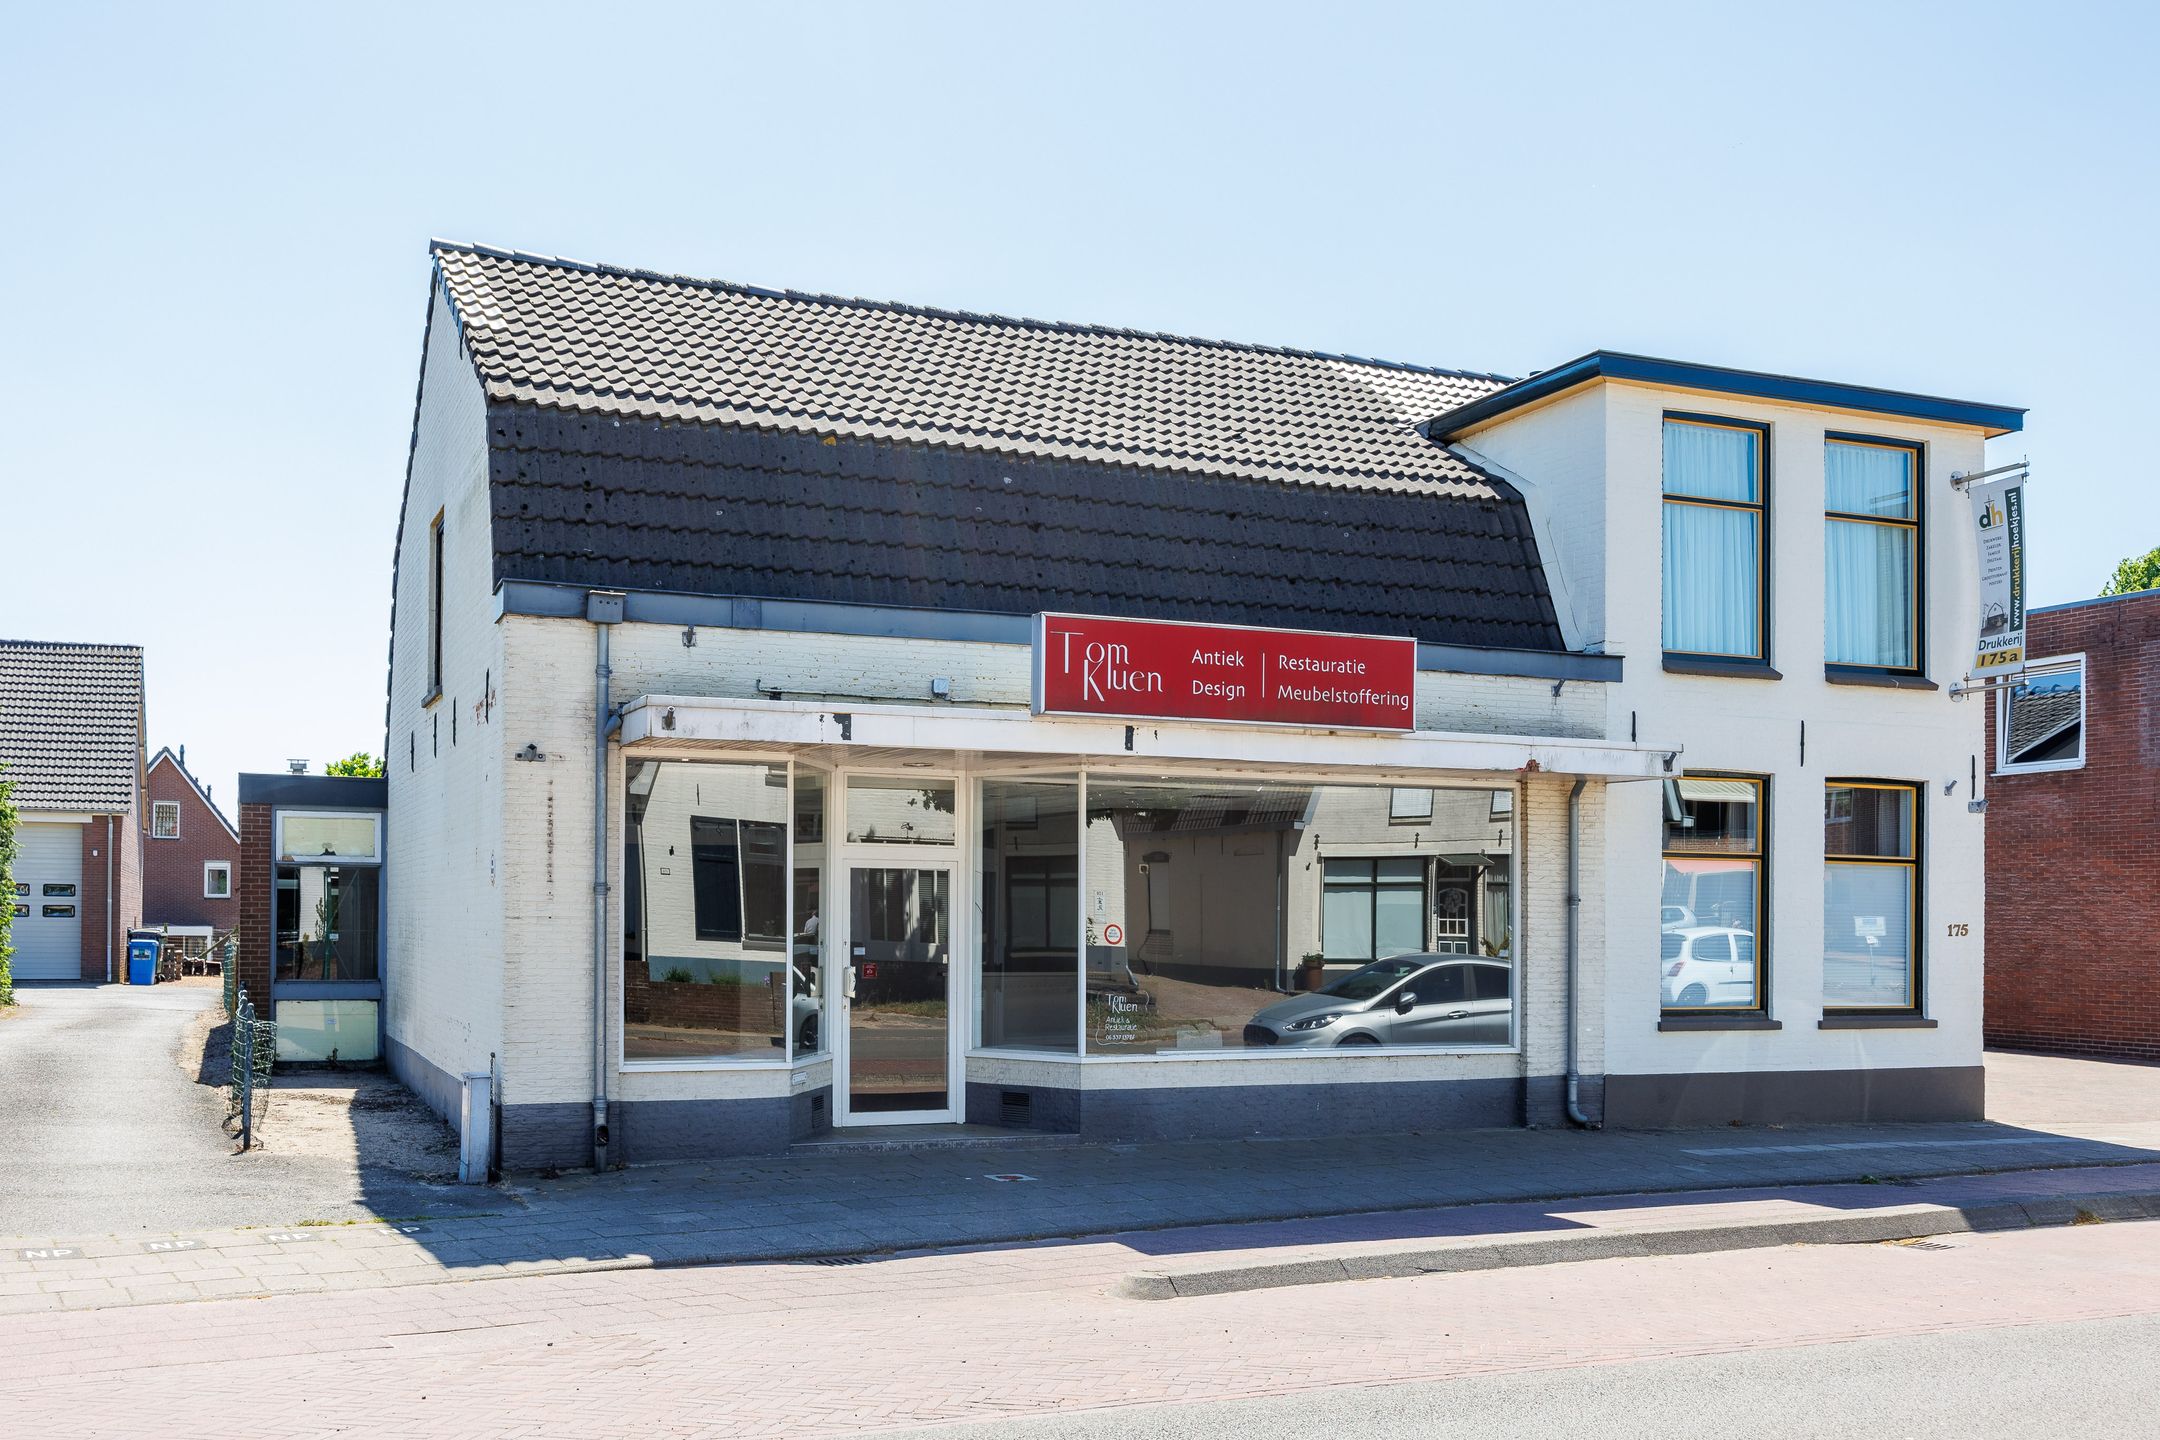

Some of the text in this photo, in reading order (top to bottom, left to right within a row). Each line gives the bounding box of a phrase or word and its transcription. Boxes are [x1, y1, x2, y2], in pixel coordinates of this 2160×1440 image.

[2008, 492, 2022, 628] www.drukkerijhoekjes.nl
[1979, 632, 2022, 651] Drukkerij
[1049, 631, 1130, 674] Tom
[1191, 649, 1245, 668] Antiek
[1278, 654, 1366, 675] Restauratie
[1083, 659, 1163, 702] Kluen
[1192, 680, 1245, 701] Design
[1277, 684, 1410, 711] Meubelstoffering
[1947, 923, 1969, 937] 175
[25, 1249, 73, 1259] NP
[150, 1240, 195, 1250] NP
